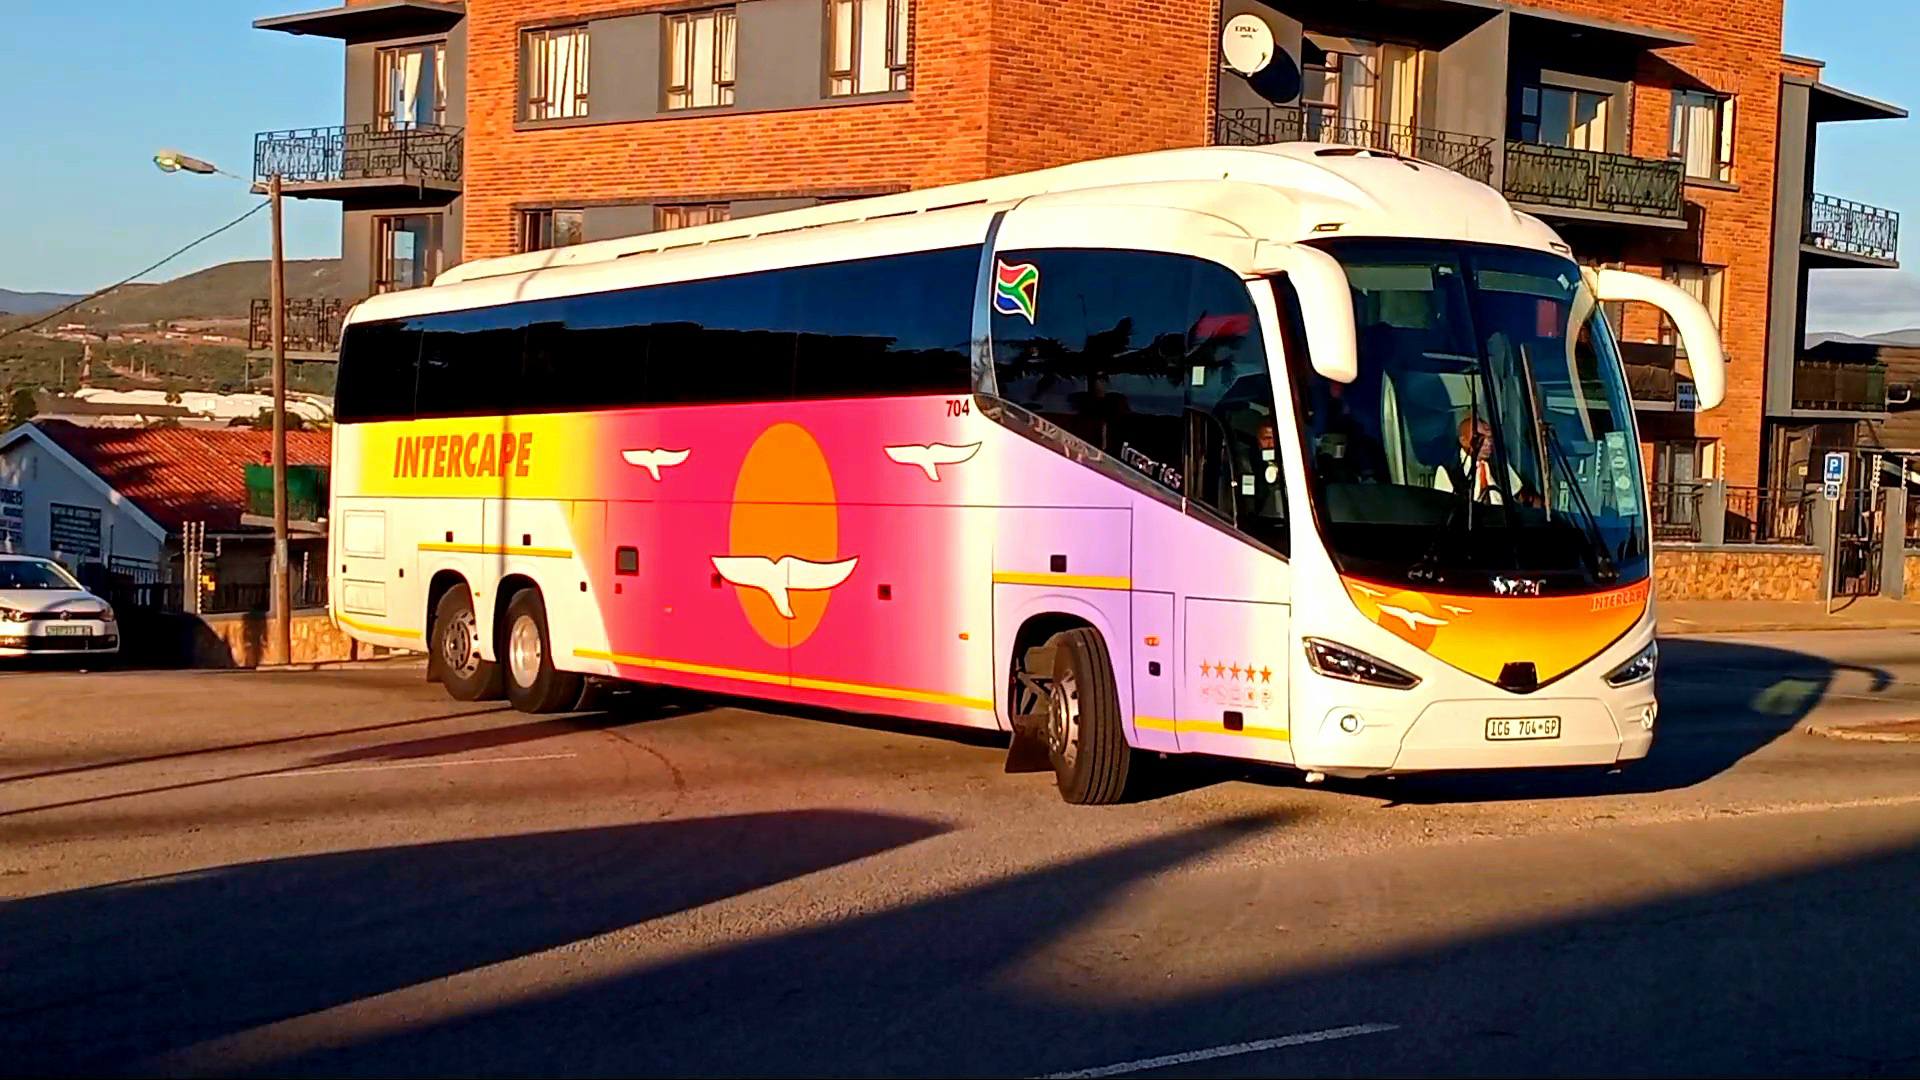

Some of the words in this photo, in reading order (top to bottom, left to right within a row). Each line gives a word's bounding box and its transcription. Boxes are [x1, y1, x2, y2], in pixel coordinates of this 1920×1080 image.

[946, 399, 970, 417] 704
[393, 432, 533, 478] INTERCAPE
[1491, 721, 1510, 736] ICG
